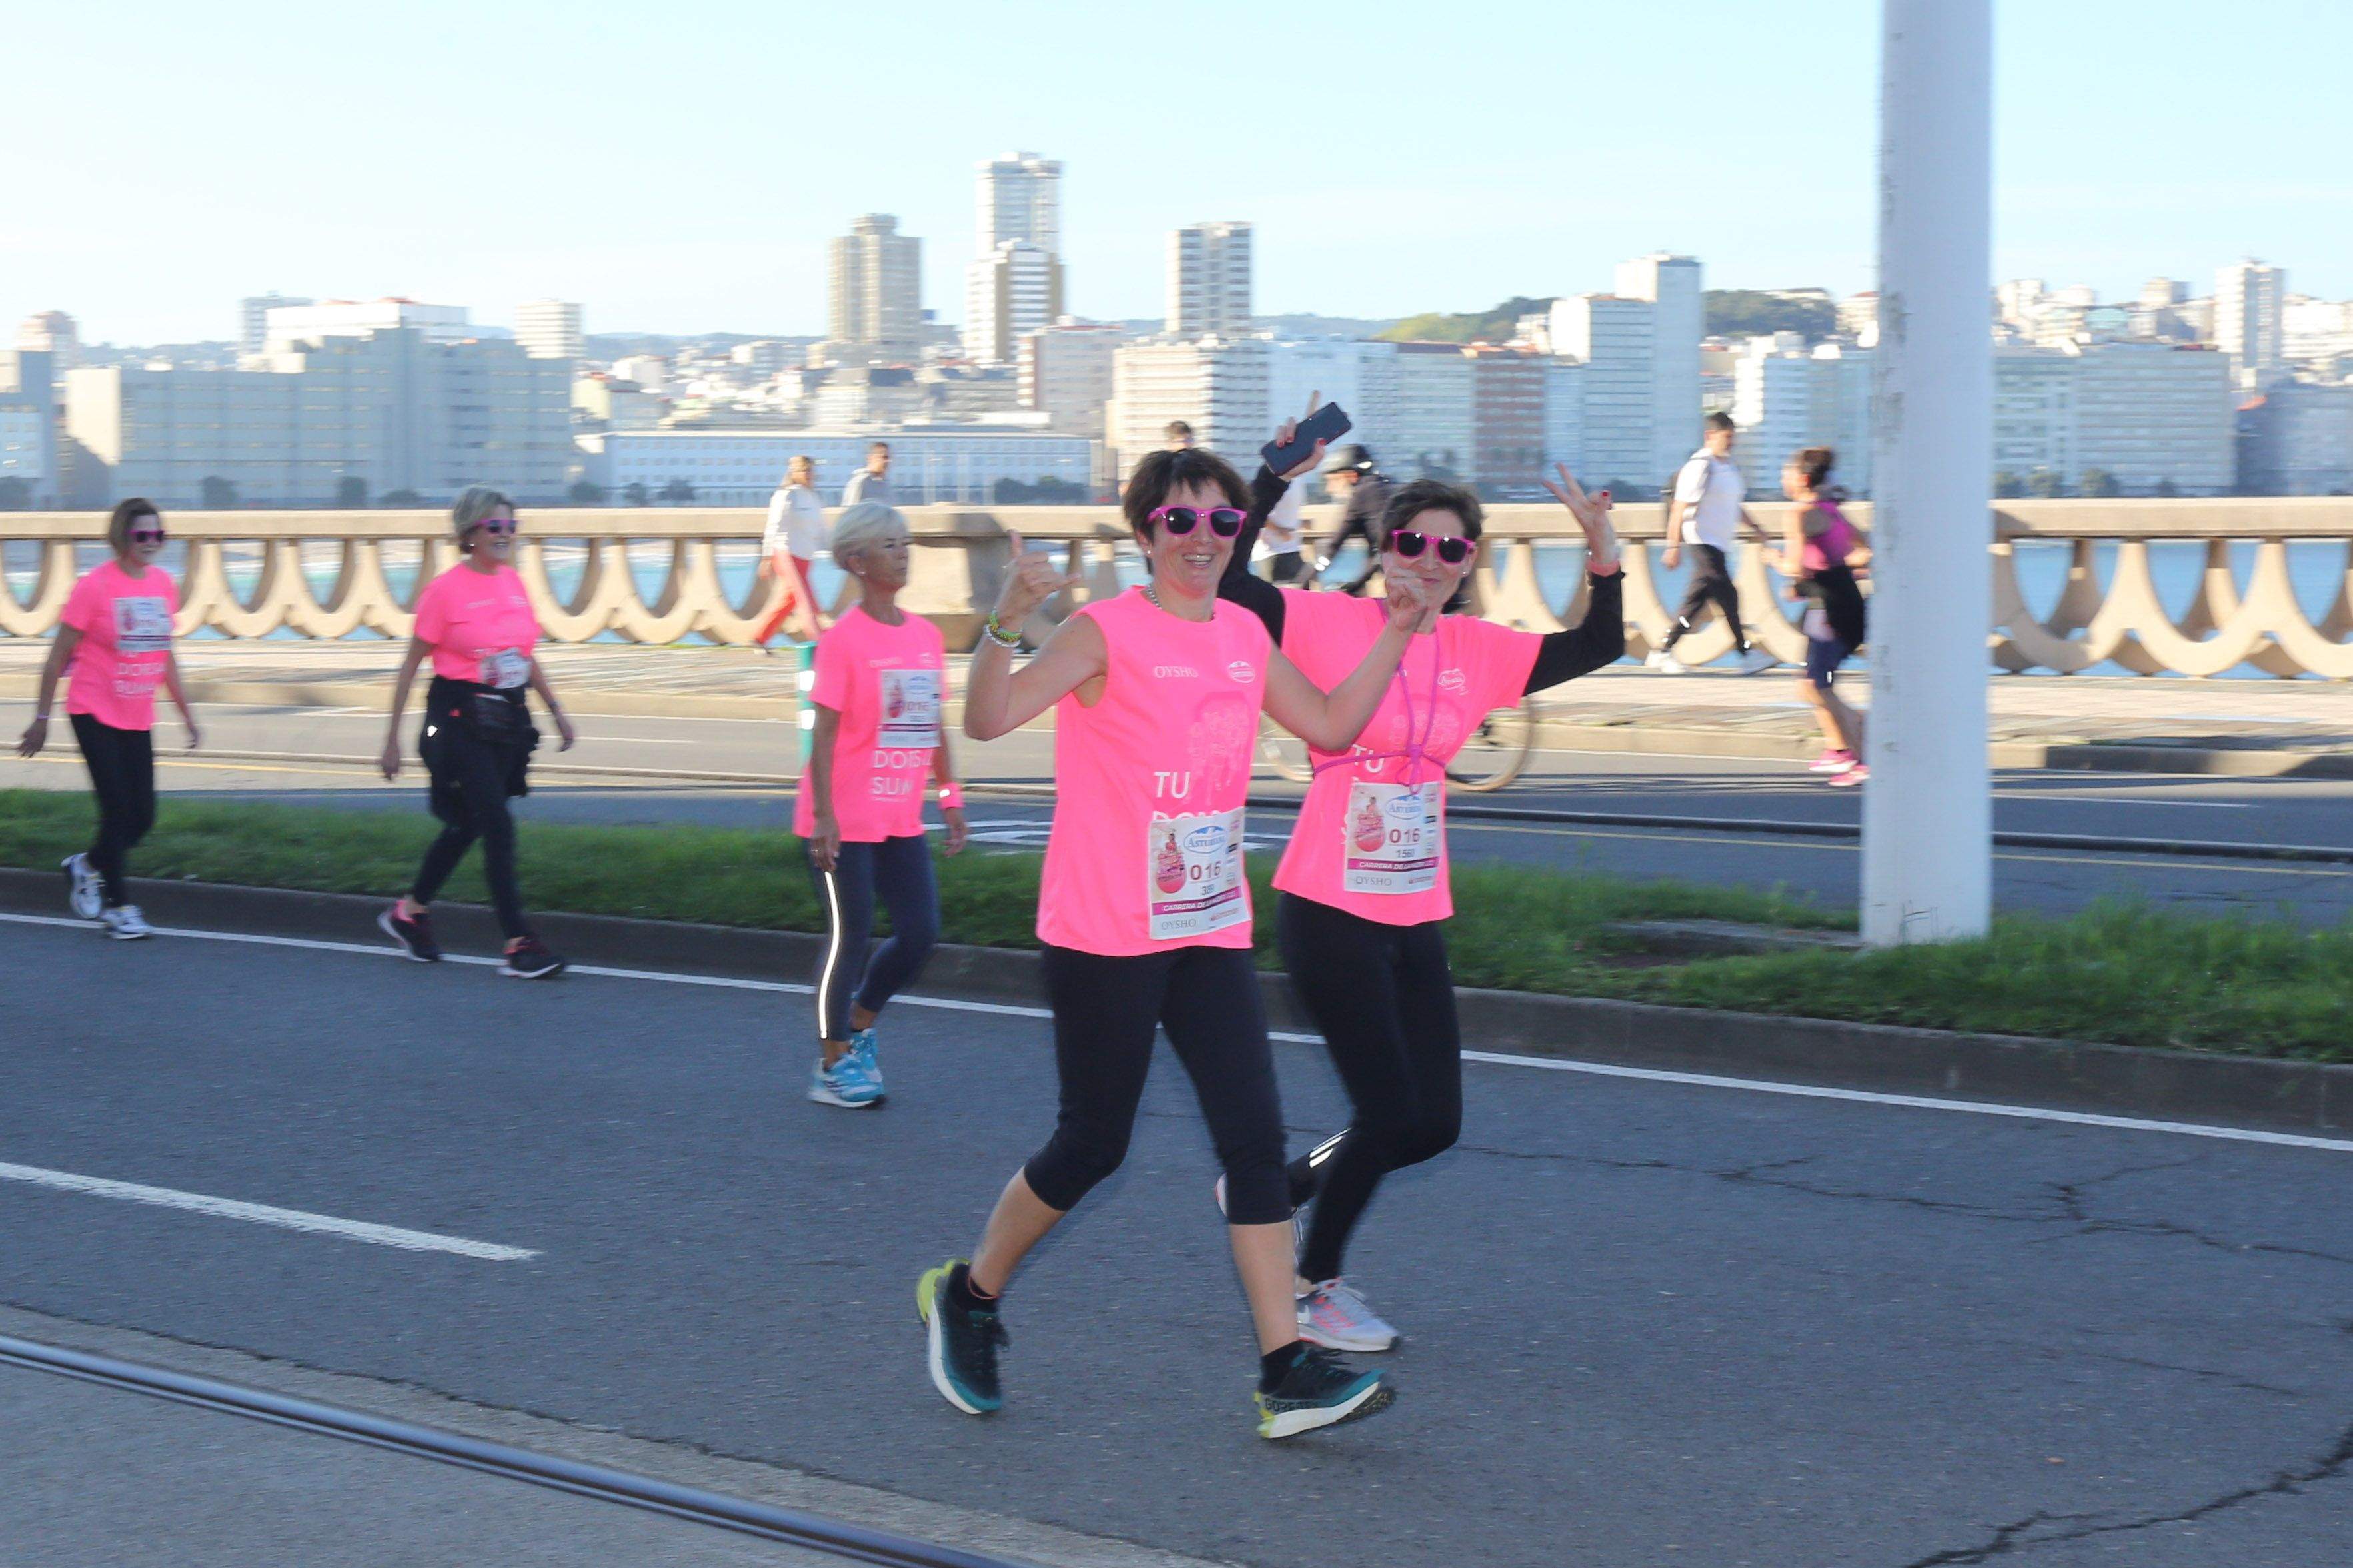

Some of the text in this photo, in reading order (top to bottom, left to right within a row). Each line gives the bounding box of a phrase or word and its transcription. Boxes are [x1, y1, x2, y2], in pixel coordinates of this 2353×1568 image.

[1154, 665, 1199, 678] OYSHO
[1351, 743, 1385, 773] TU
[1154, 771, 1191, 798] TU
[1355, 876, 1392, 886] OYSHO
[1161, 919, 1197, 930] OYSHO
